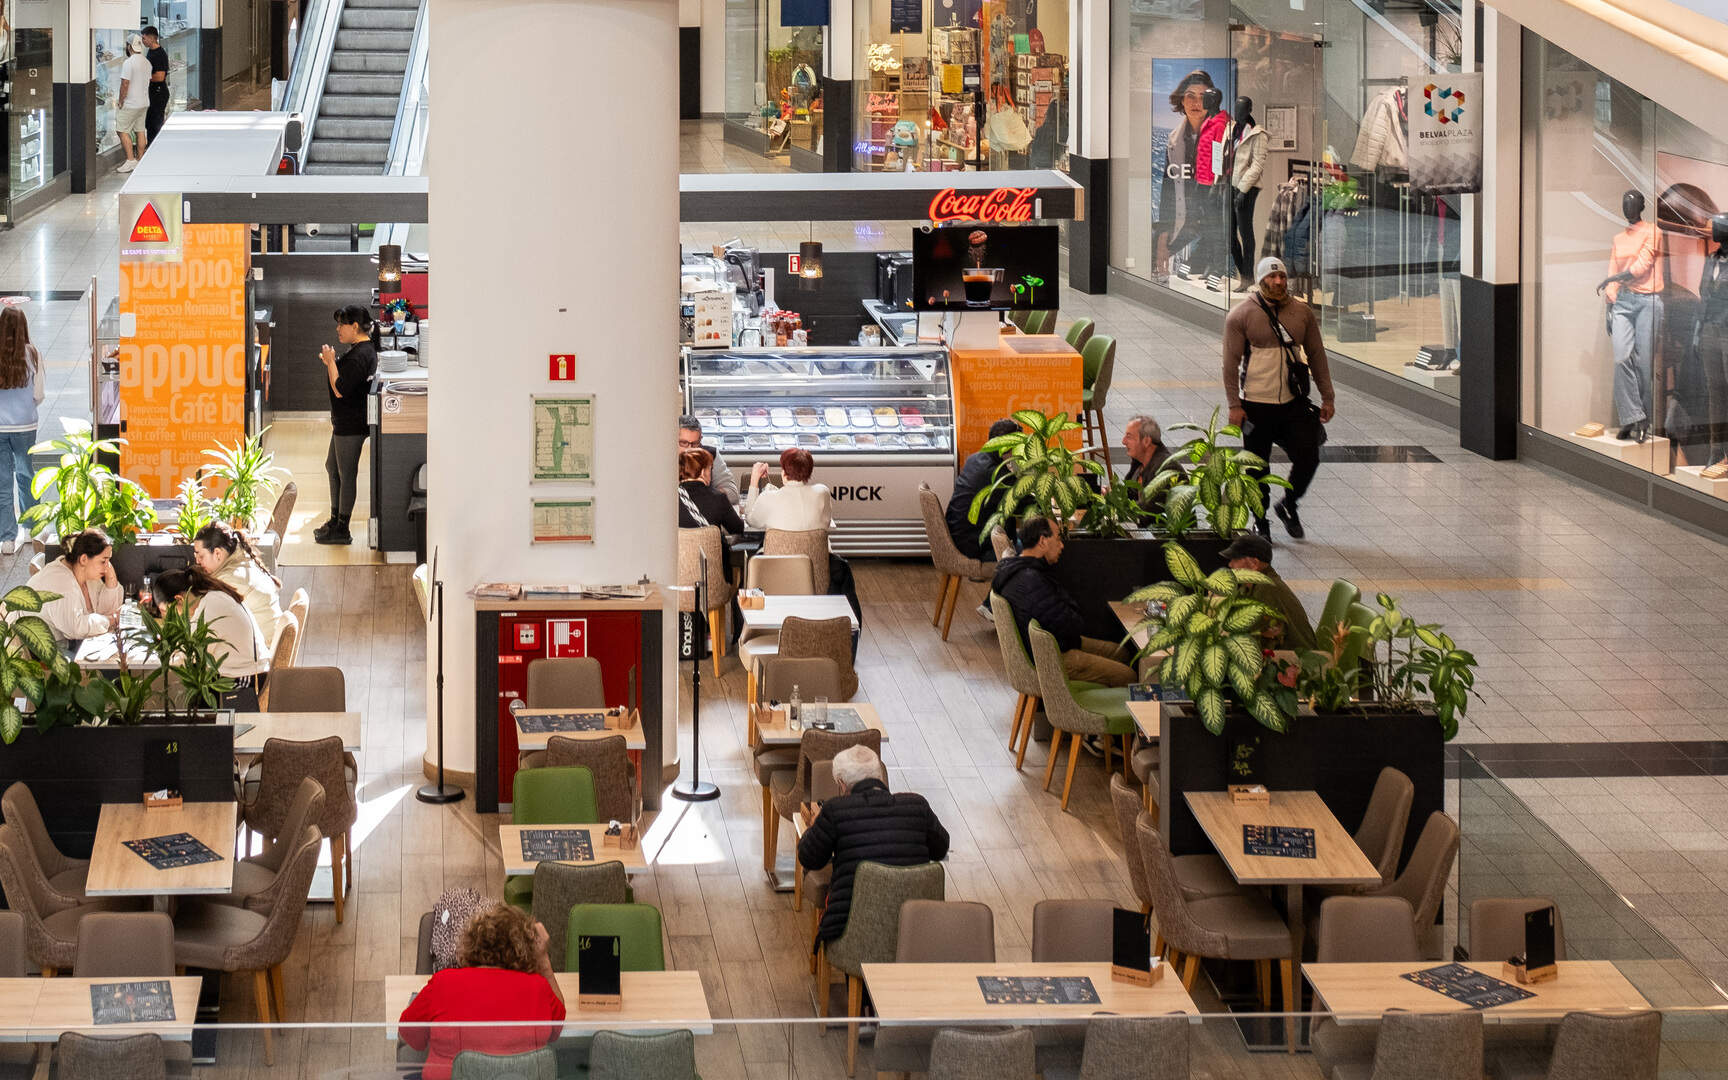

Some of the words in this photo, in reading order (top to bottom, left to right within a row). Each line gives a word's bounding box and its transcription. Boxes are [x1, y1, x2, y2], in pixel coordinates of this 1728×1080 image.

[1166, 163, 1195, 179] CE
[929, 186, 1038, 223] Coca-Cola
[137, 225, 162, 234] DELTA
[132, 247, 232, 299] Doppio
[133, 300, 182, 320] Espresso
[184, 300, 229, 316] Romano
[170, 392, 217, 424] Café
[166, 741, 178, 754] 18
[580, 936, 591, 950] 16
